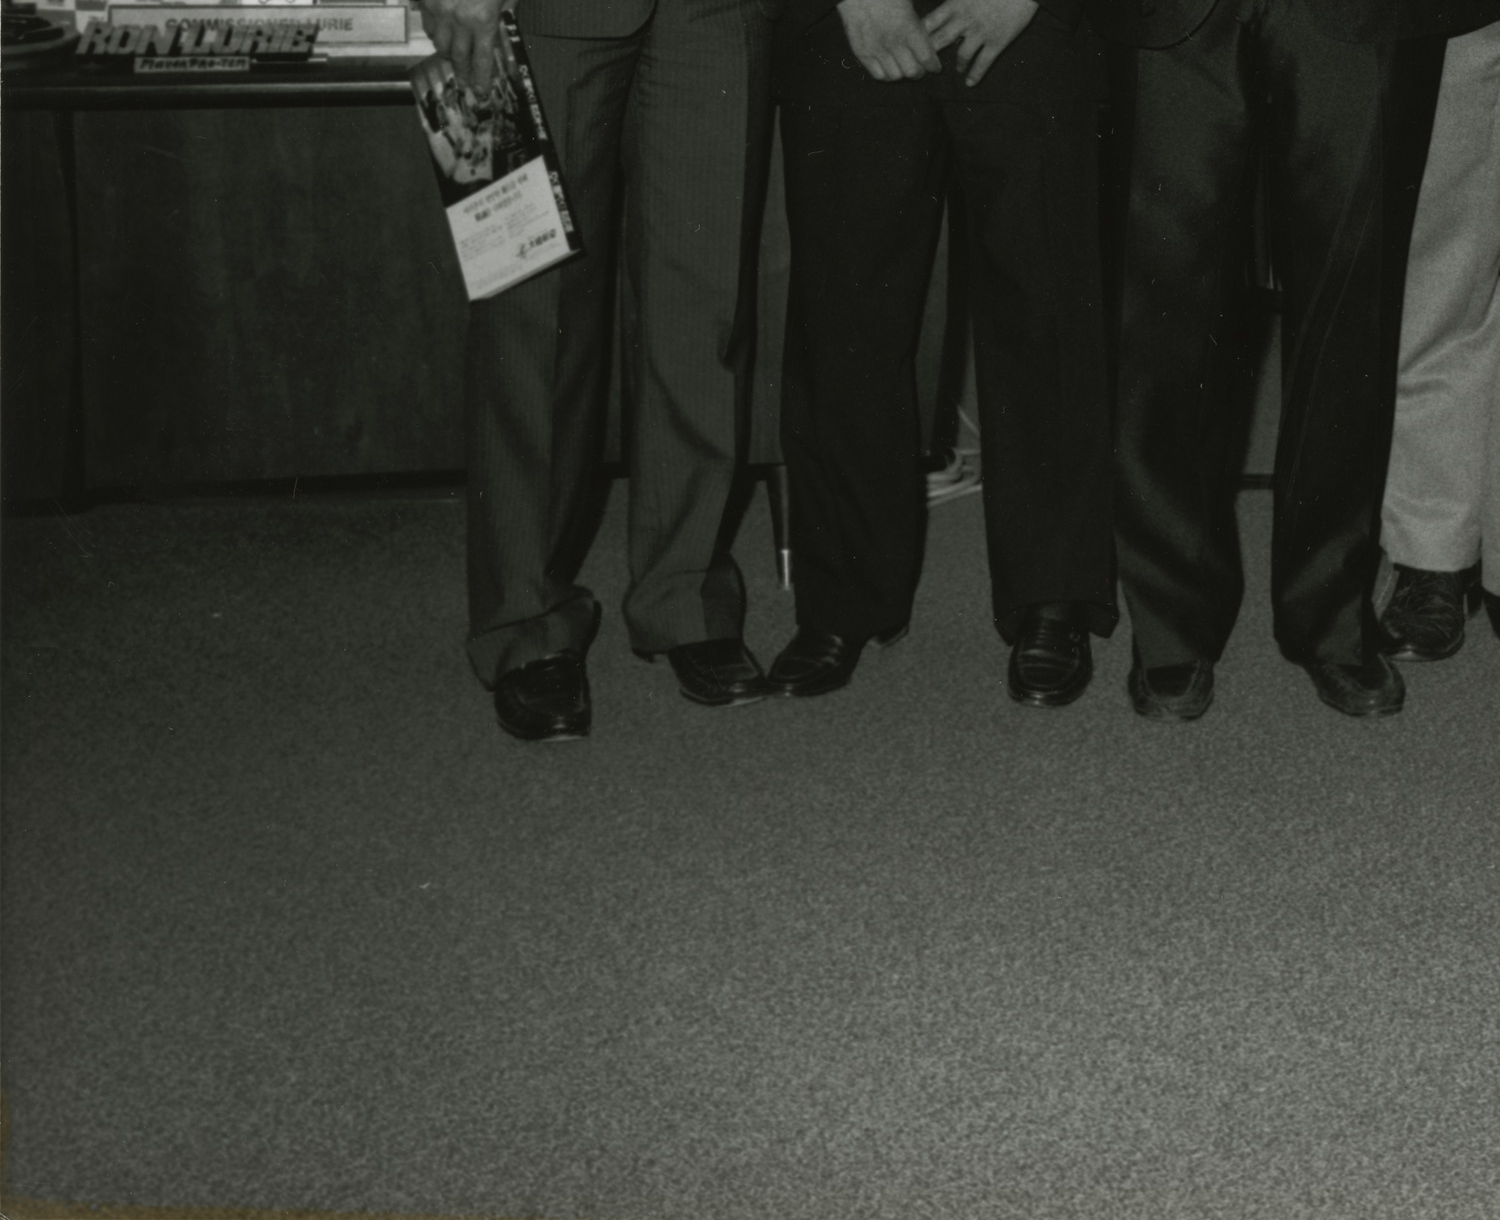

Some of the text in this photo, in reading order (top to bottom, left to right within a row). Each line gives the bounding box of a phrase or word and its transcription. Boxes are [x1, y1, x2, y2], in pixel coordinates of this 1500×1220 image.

[308, 18, 354, 31] URIE
[75, 20, 317, 55] RON LURIE
